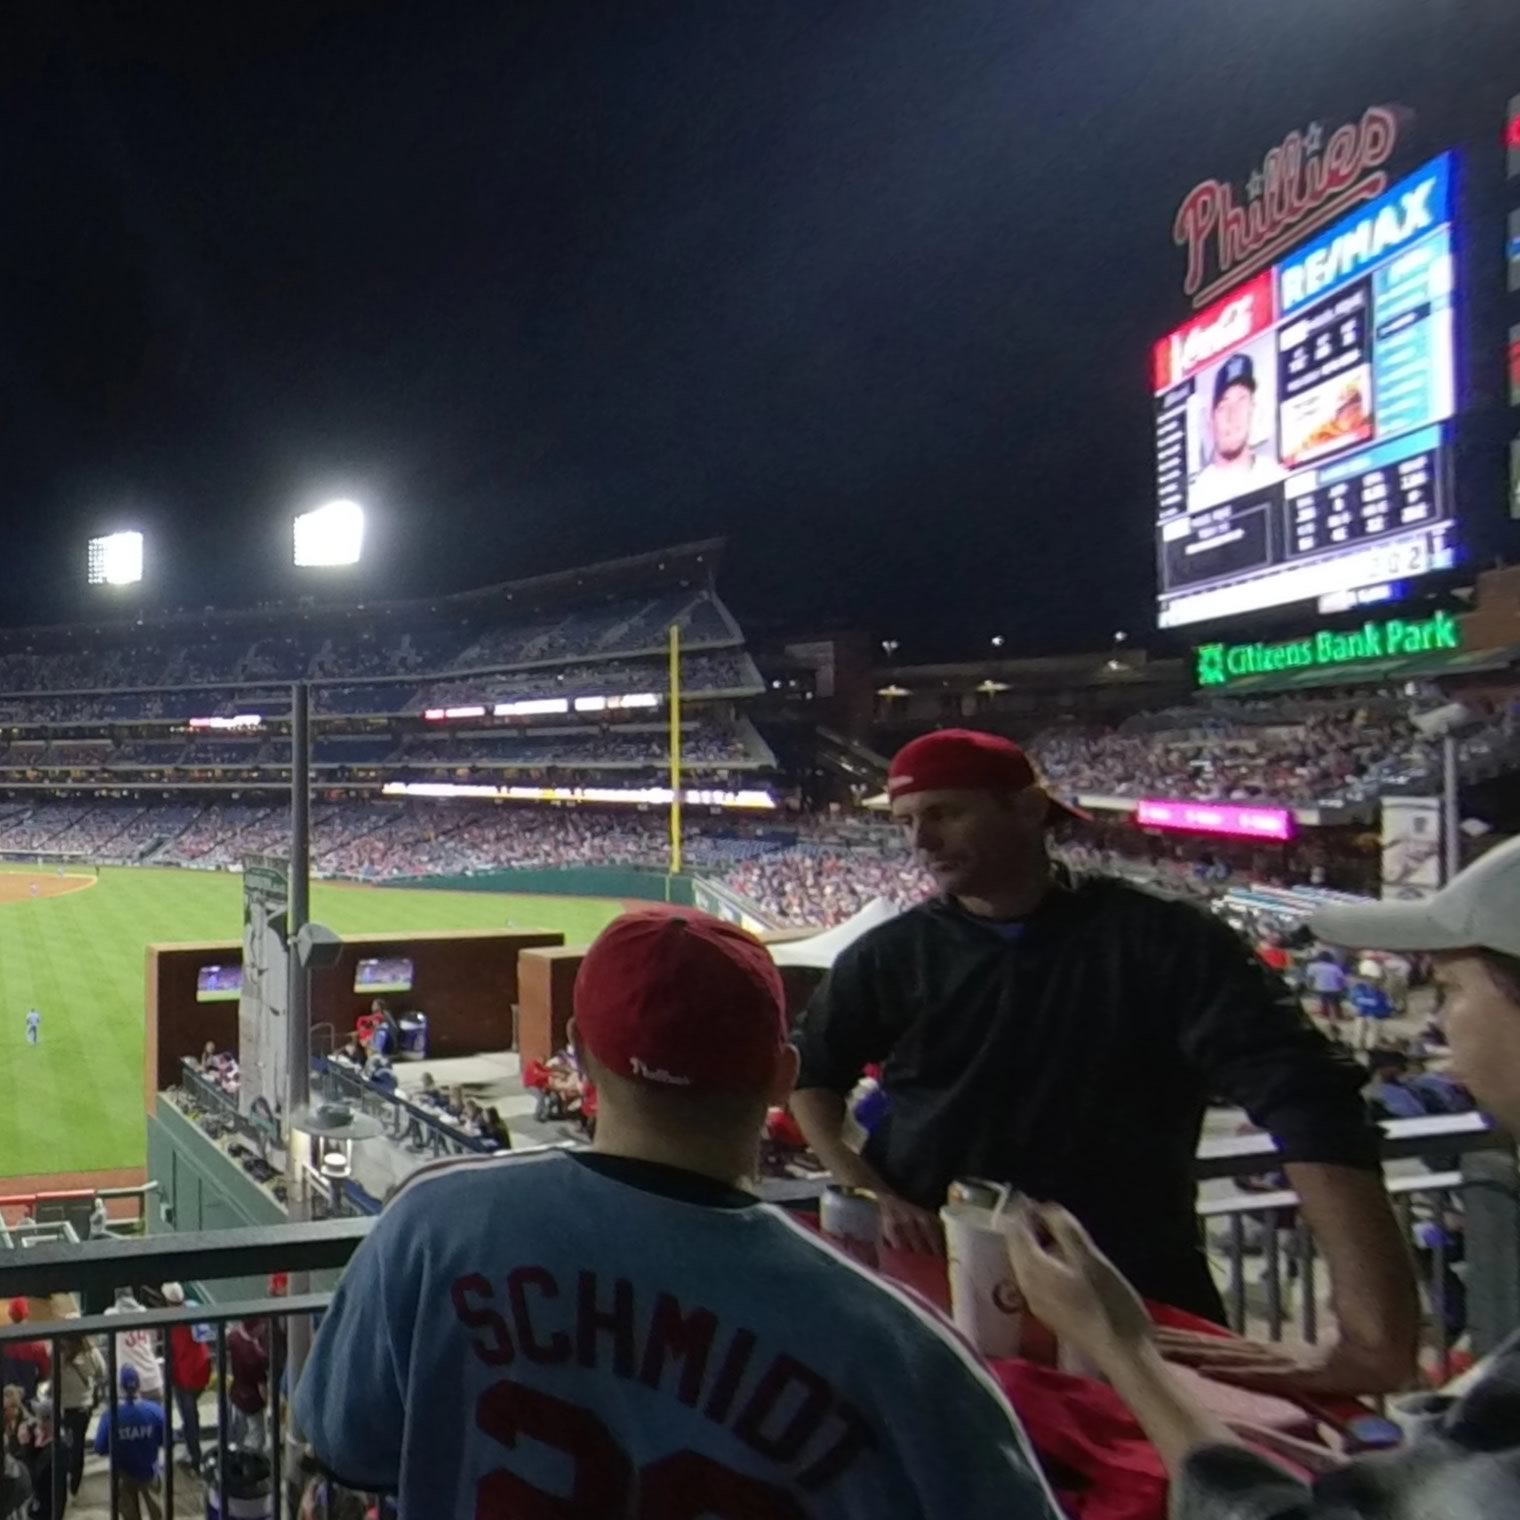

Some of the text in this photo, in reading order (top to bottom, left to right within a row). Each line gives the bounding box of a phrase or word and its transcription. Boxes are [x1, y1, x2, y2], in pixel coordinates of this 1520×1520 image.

[1174, 105, 1396, 295] Phillies
[1281, 175, 1438, 309] RE/MAX
[1226, 609, 1458, 676] Citizens Bank Park
[118, 1424, 154, 1441] STAFF
[450, 1264, 877, 1492] SCHMIDT
